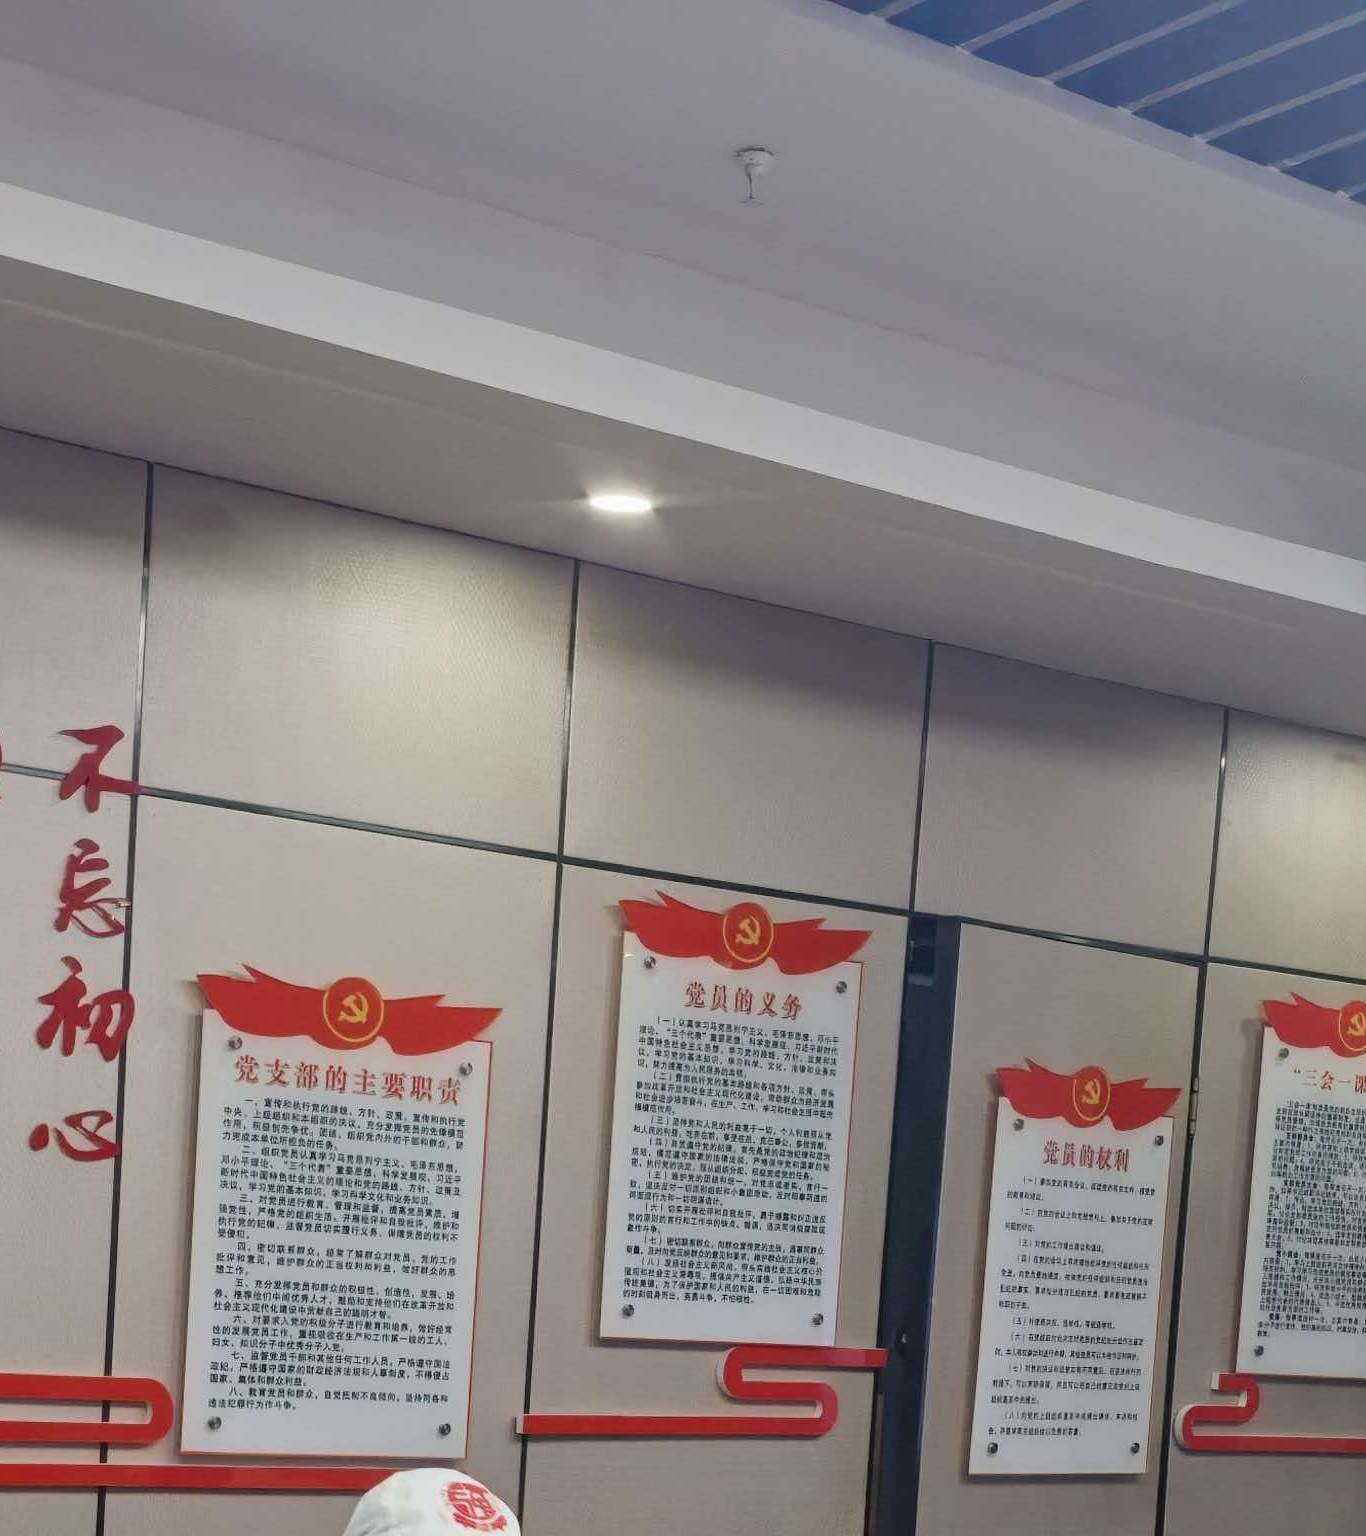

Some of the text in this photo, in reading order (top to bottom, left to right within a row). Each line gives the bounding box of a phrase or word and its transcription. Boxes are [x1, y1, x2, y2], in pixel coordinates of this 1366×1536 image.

[29, 724, 139, 1161] 不忘初心
[684, 981, 803, 1021] 党员的义务
[233, 1055, 462, 1105] 党支部的主要职责
[1043, 1140, 1130, 1170] 党员的权利
